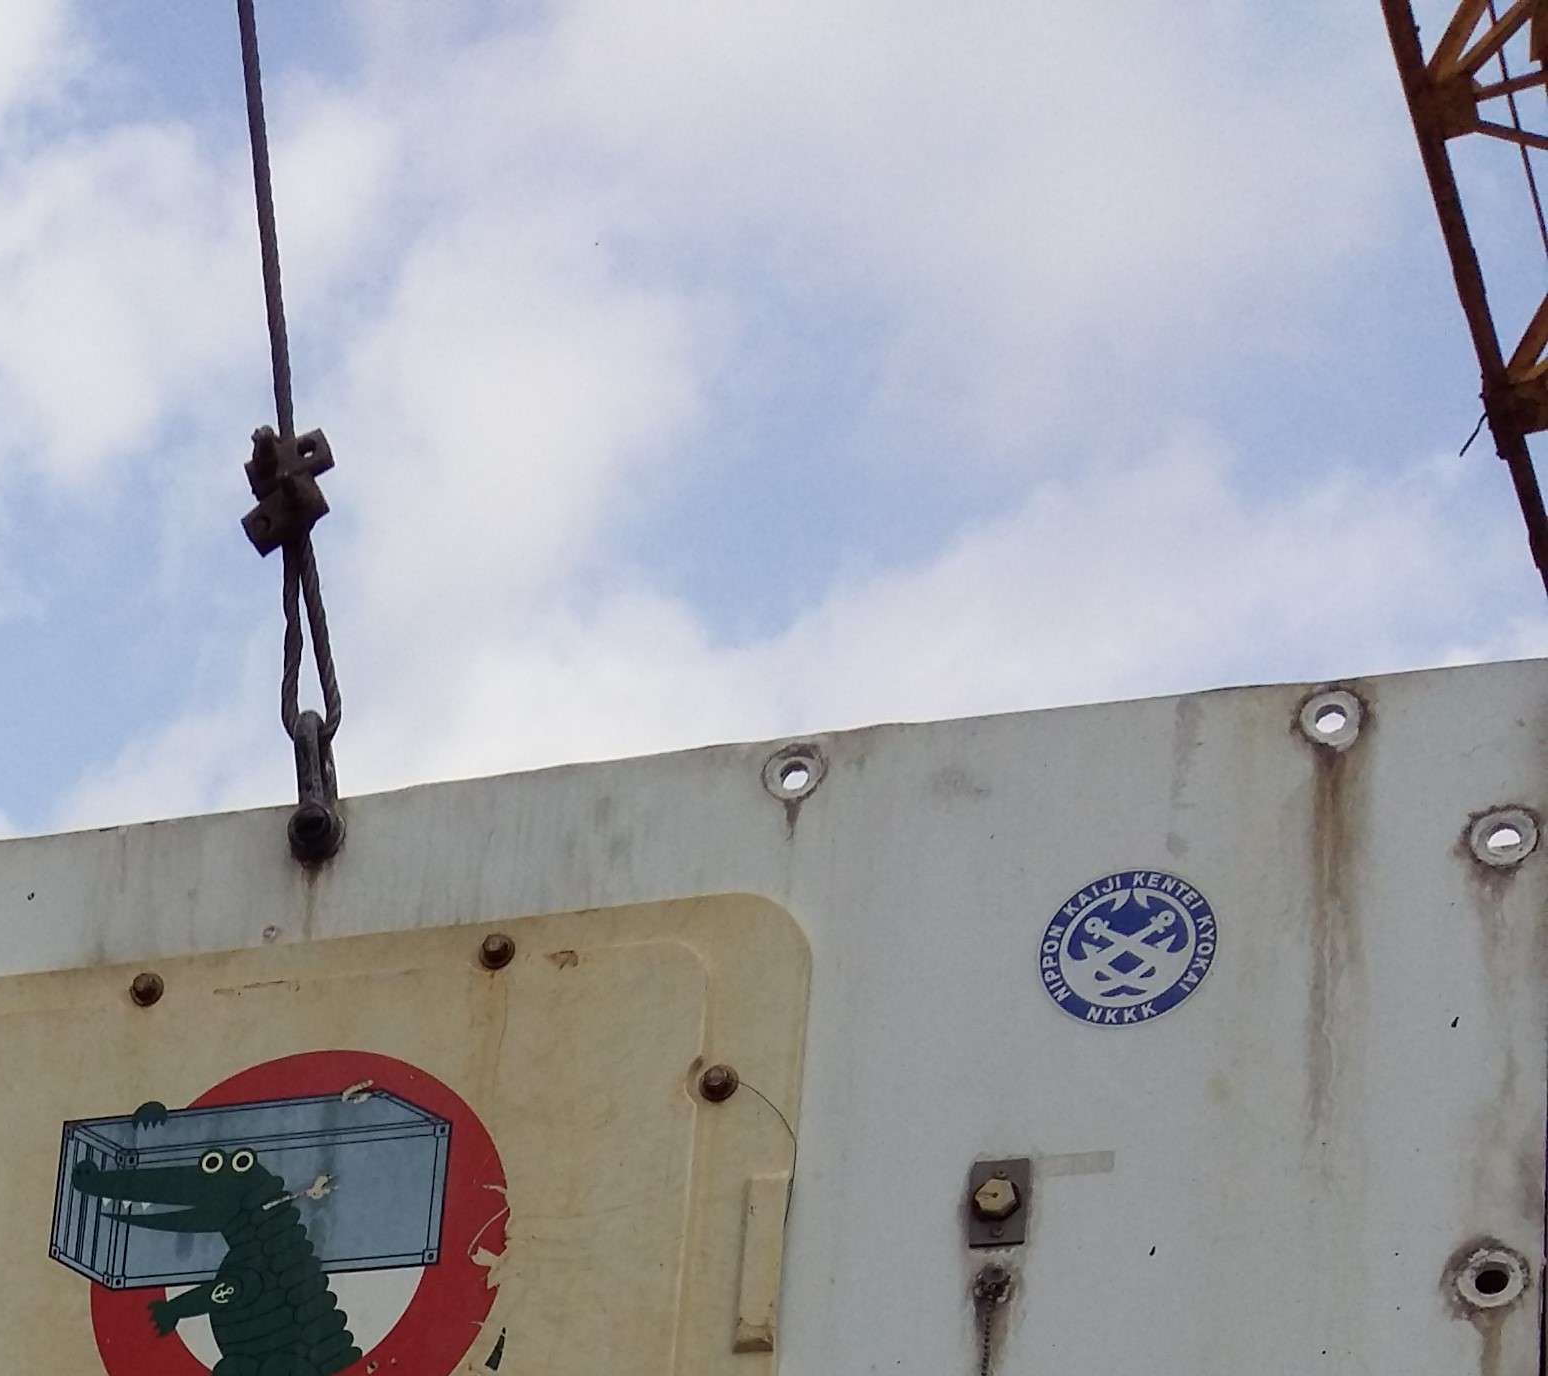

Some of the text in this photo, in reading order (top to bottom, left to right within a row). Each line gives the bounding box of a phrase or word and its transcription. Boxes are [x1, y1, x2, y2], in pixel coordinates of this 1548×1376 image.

[1042, 872, 1216, 1002] NIPPON KAIJI KENTEI KYOKAI
[1086, 1002, 1158, 1024] NKKK
